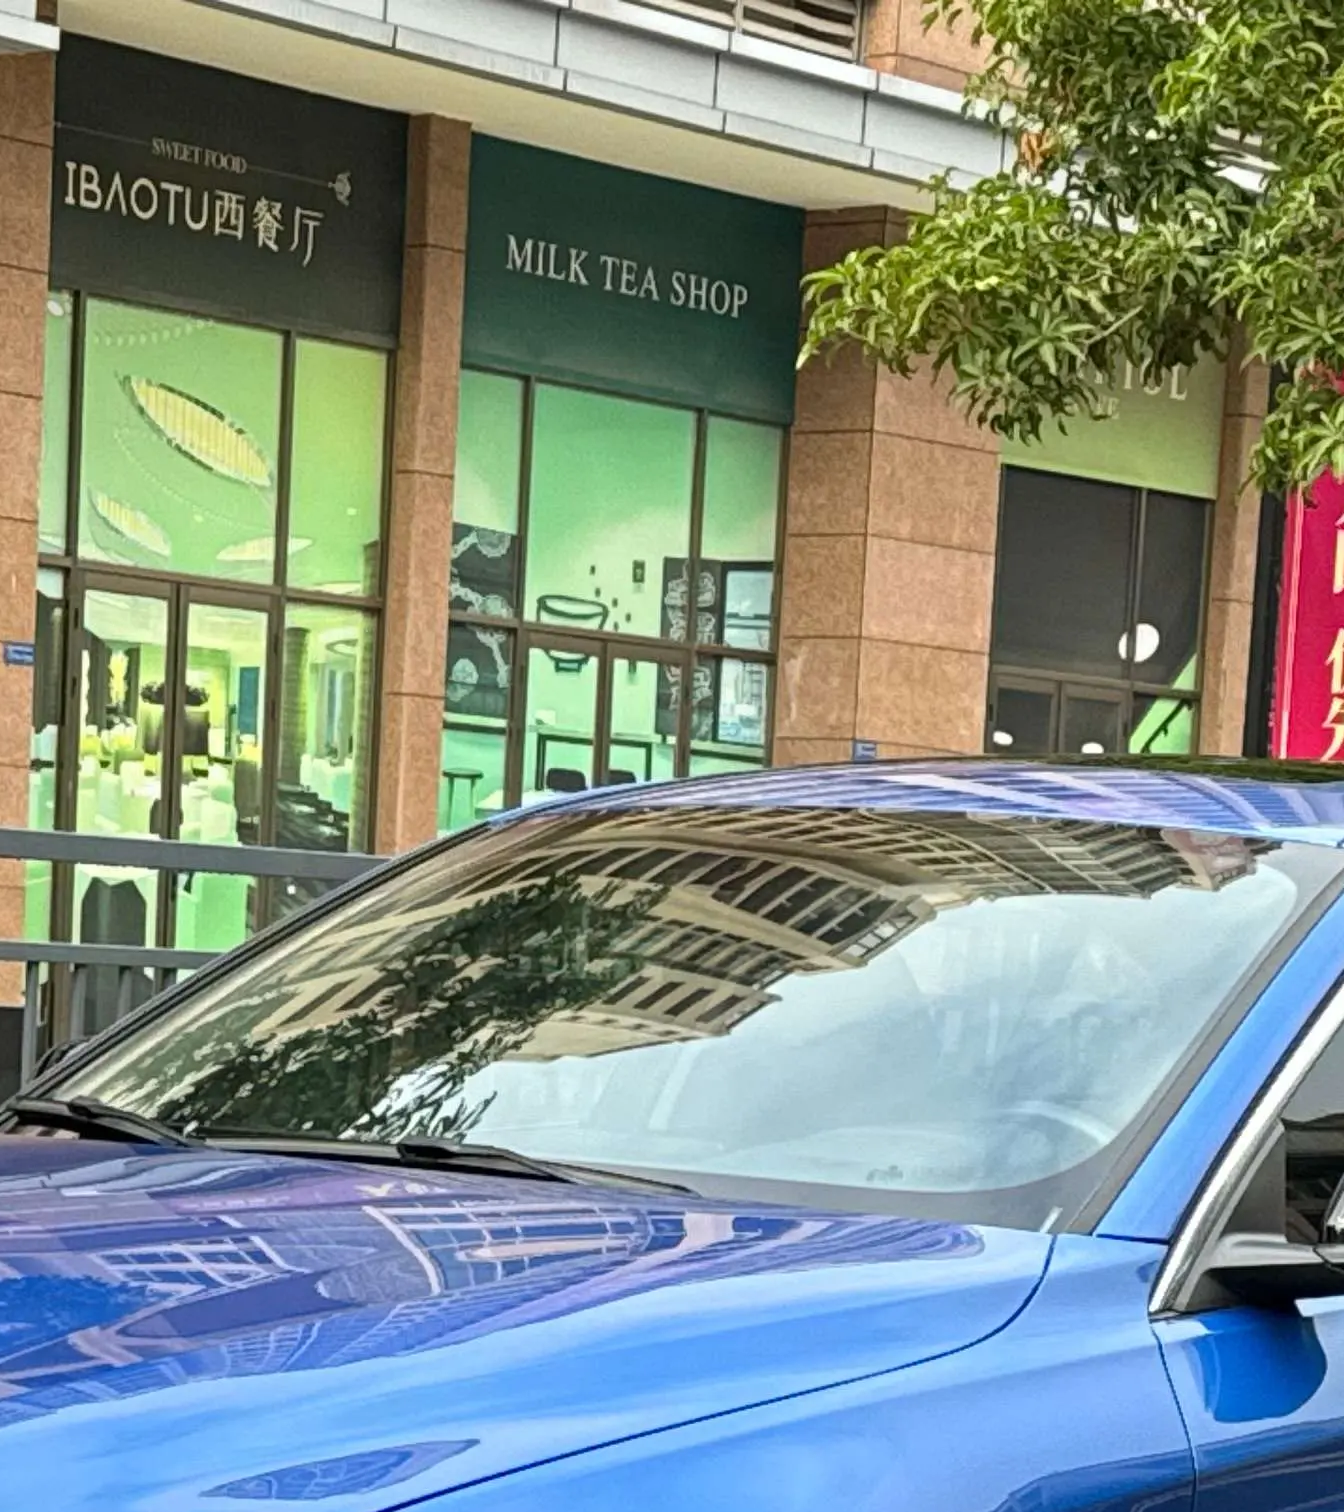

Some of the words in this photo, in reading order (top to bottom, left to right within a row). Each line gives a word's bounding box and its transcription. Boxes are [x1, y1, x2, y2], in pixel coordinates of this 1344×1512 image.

[152, 137, 202, 164] SWEET
[205, 149, 248, 174] FOOD
[506, 233, 590, 286] MILK
[600, 255, 660, 302] TEA
[670, 270, 748, 319] SHOP
